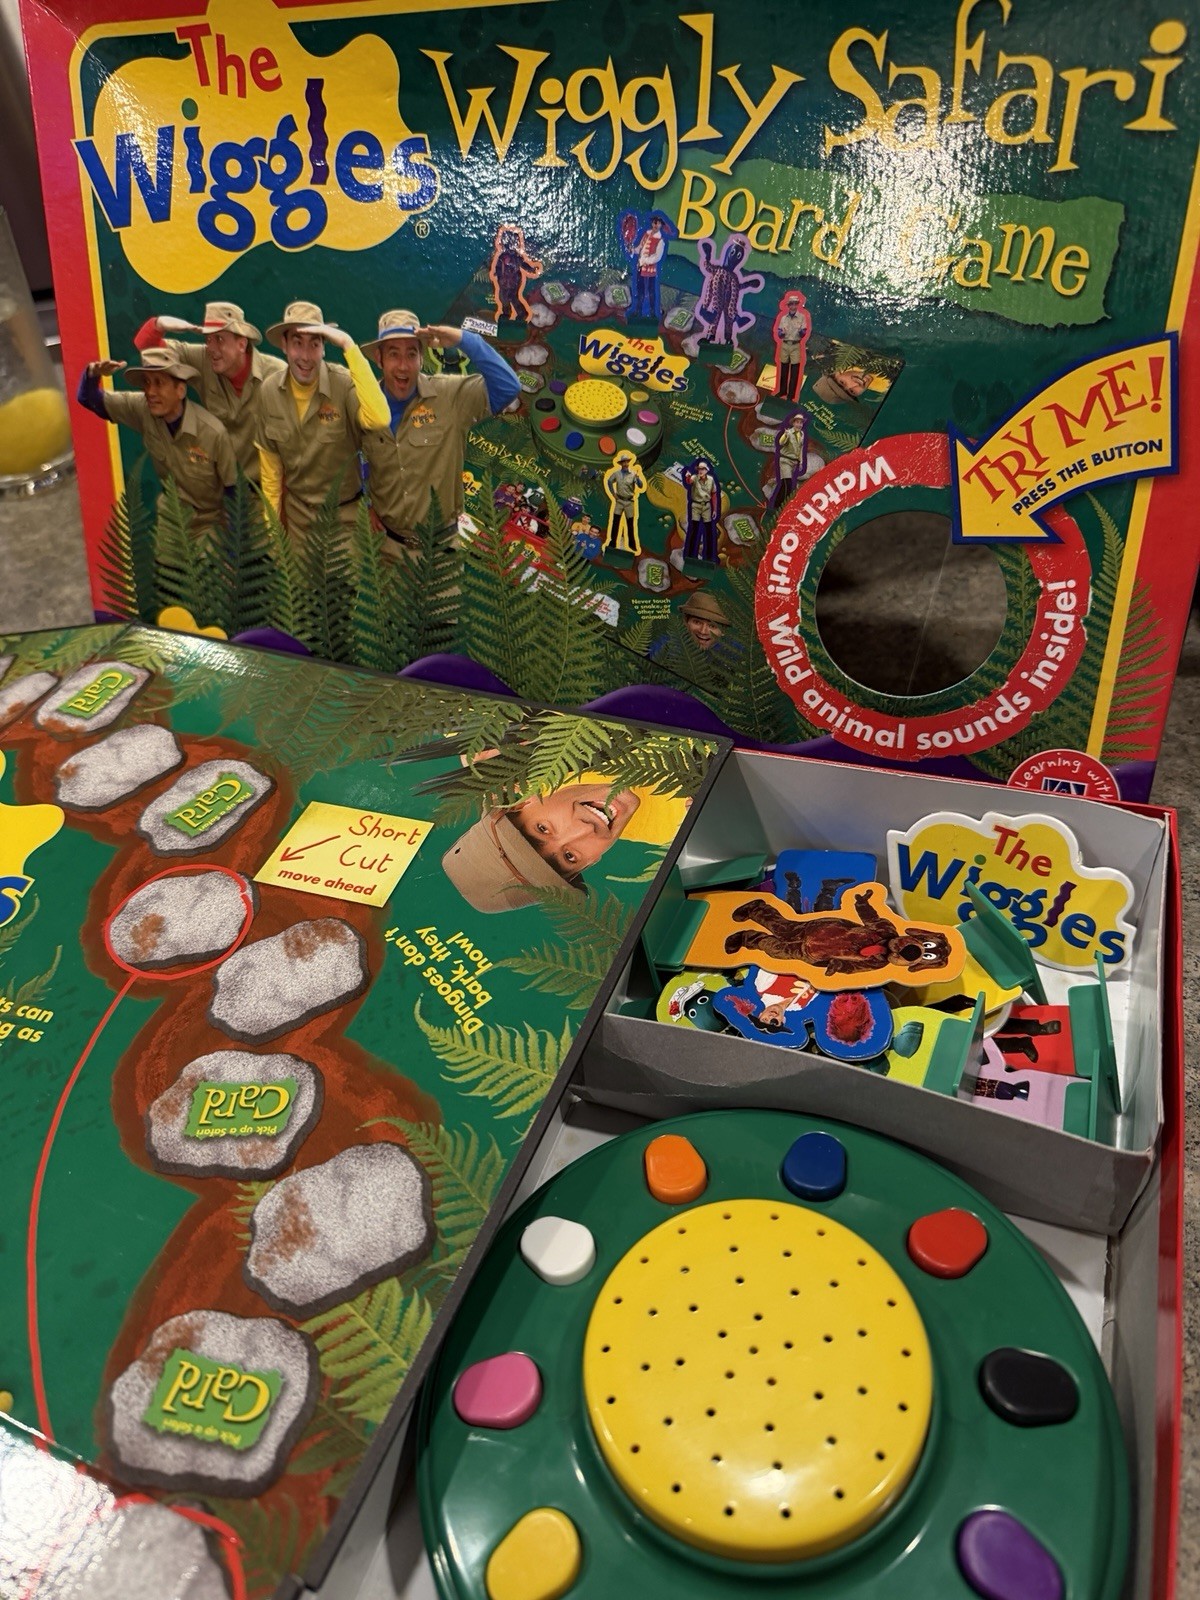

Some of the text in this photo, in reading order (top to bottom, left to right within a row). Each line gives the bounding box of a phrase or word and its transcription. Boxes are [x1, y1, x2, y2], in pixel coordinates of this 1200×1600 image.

[175, 22, 283, 99] The
[418, 0, 1187, 191] Wiggly Safari
[74, 77, 440, 252] Wiggles
[677, 169, 863, 270] Board
[579, 334, 689, 392] Wiggles
[468, 431, 513, 461] Wiggly
[513, 454, 552, 478] Safari
[962, 356, 1165, 504] TRY ME!
[1012, 438, 1163, 516] PRESS THE BUTTON
[767, 455, 1078, 750] Watch out! Wild animal sounds inside!
[68, 671, 123, 712] Card
[1014, 751, 1082, 788] Learning
[174, 780, 241, 829] Card
[348, 815, 421, 845] Short
[993, 825, 1053, 877] The
[277, 869, 377, 896] move ahead
[339, 845, 393, 873] Cut
[897, 843, 1126, 965] Wiggles
[415, 926, 493, 1010] bark, they
[446, 931, 494, 976] howl
[384, 926, 485, 1035] Dingoes don't
[16, 1003, 54, 1024] can
[17, 1025, 44, 1043] as
[198, 1085, 290, 1125] Card
[240, 1125, 254, 1134] up
[196, 1127, 227, 1138] Safari
[256, 1125, 277, 1136] Pick
[162, 1360, 271, 1422] Card
